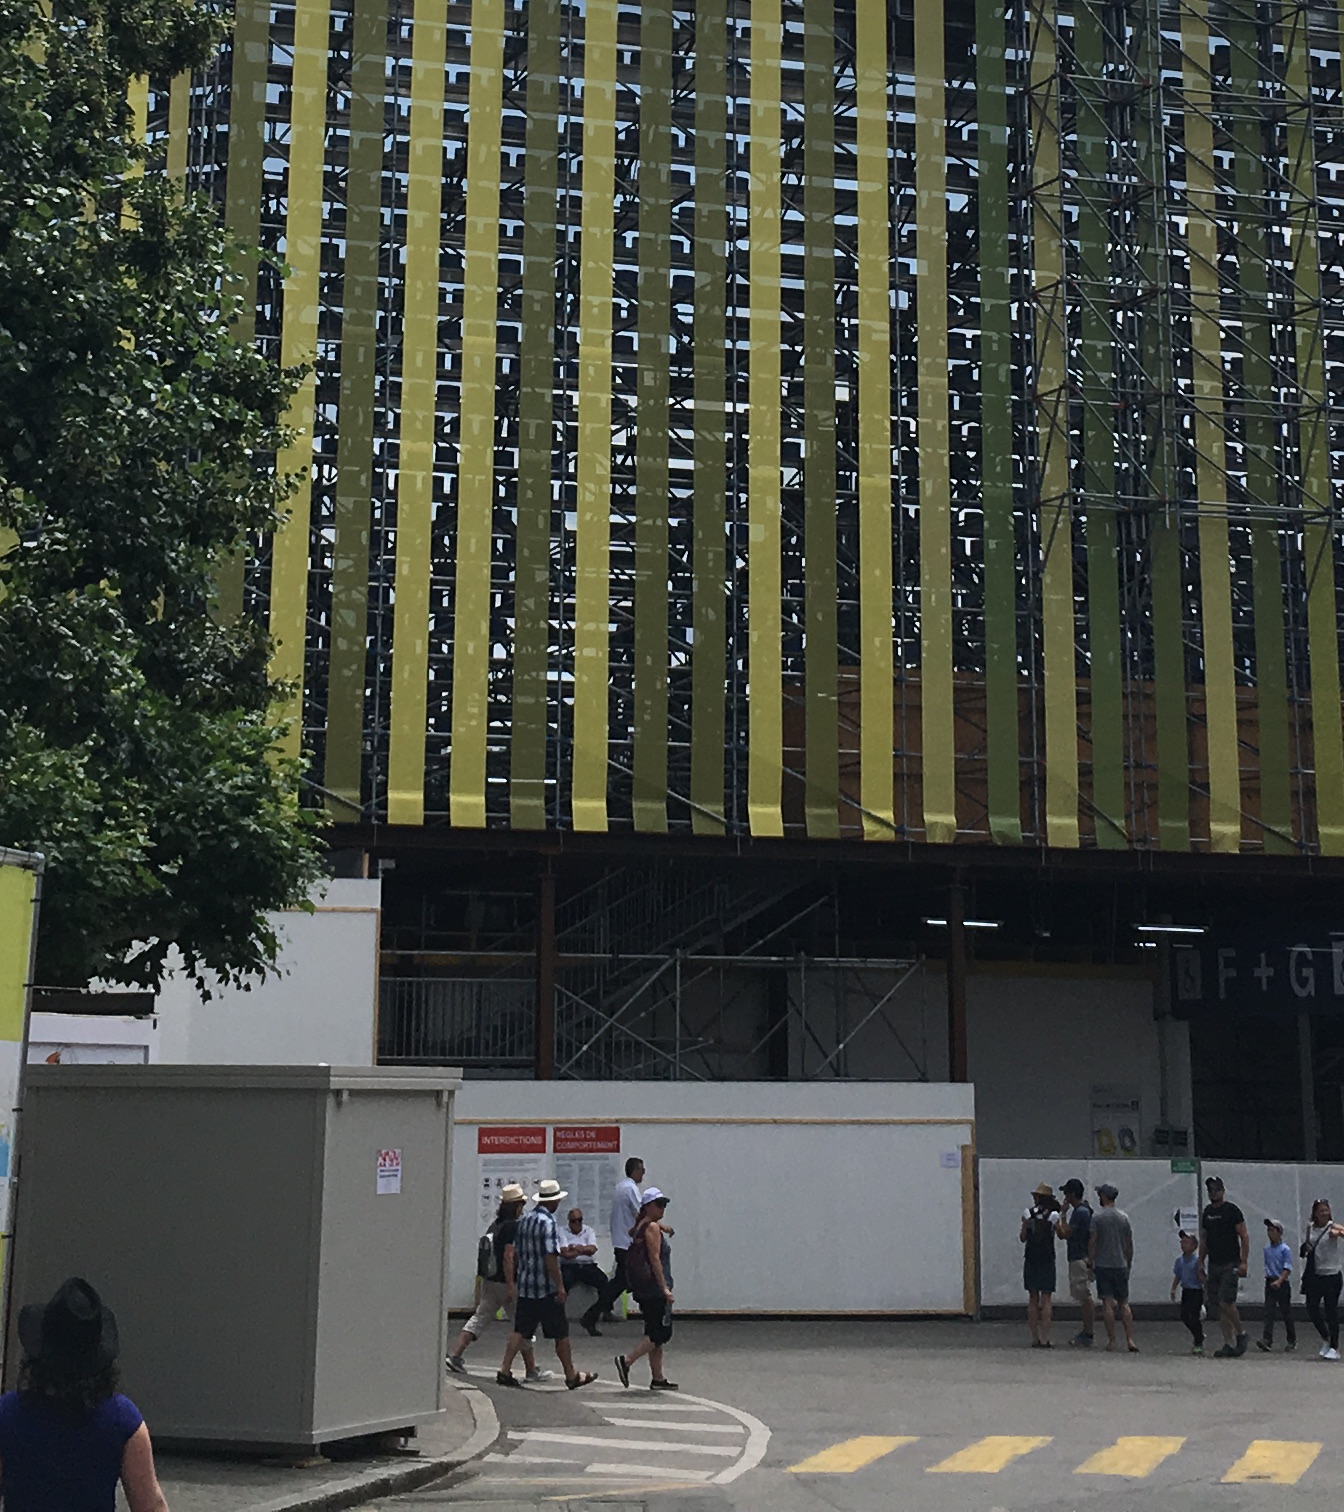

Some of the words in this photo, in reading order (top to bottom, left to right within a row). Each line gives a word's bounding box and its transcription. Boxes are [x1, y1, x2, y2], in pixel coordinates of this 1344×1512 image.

[1217, 947, 1236, 999] F
[1289, 944, 1317, 999] G
[586, 1130, 596, 1138] DE
[481, 1135, 543, 1145] INTERDICTIONS
[556, 1141, 618, 1150] COMPORTEMENT
